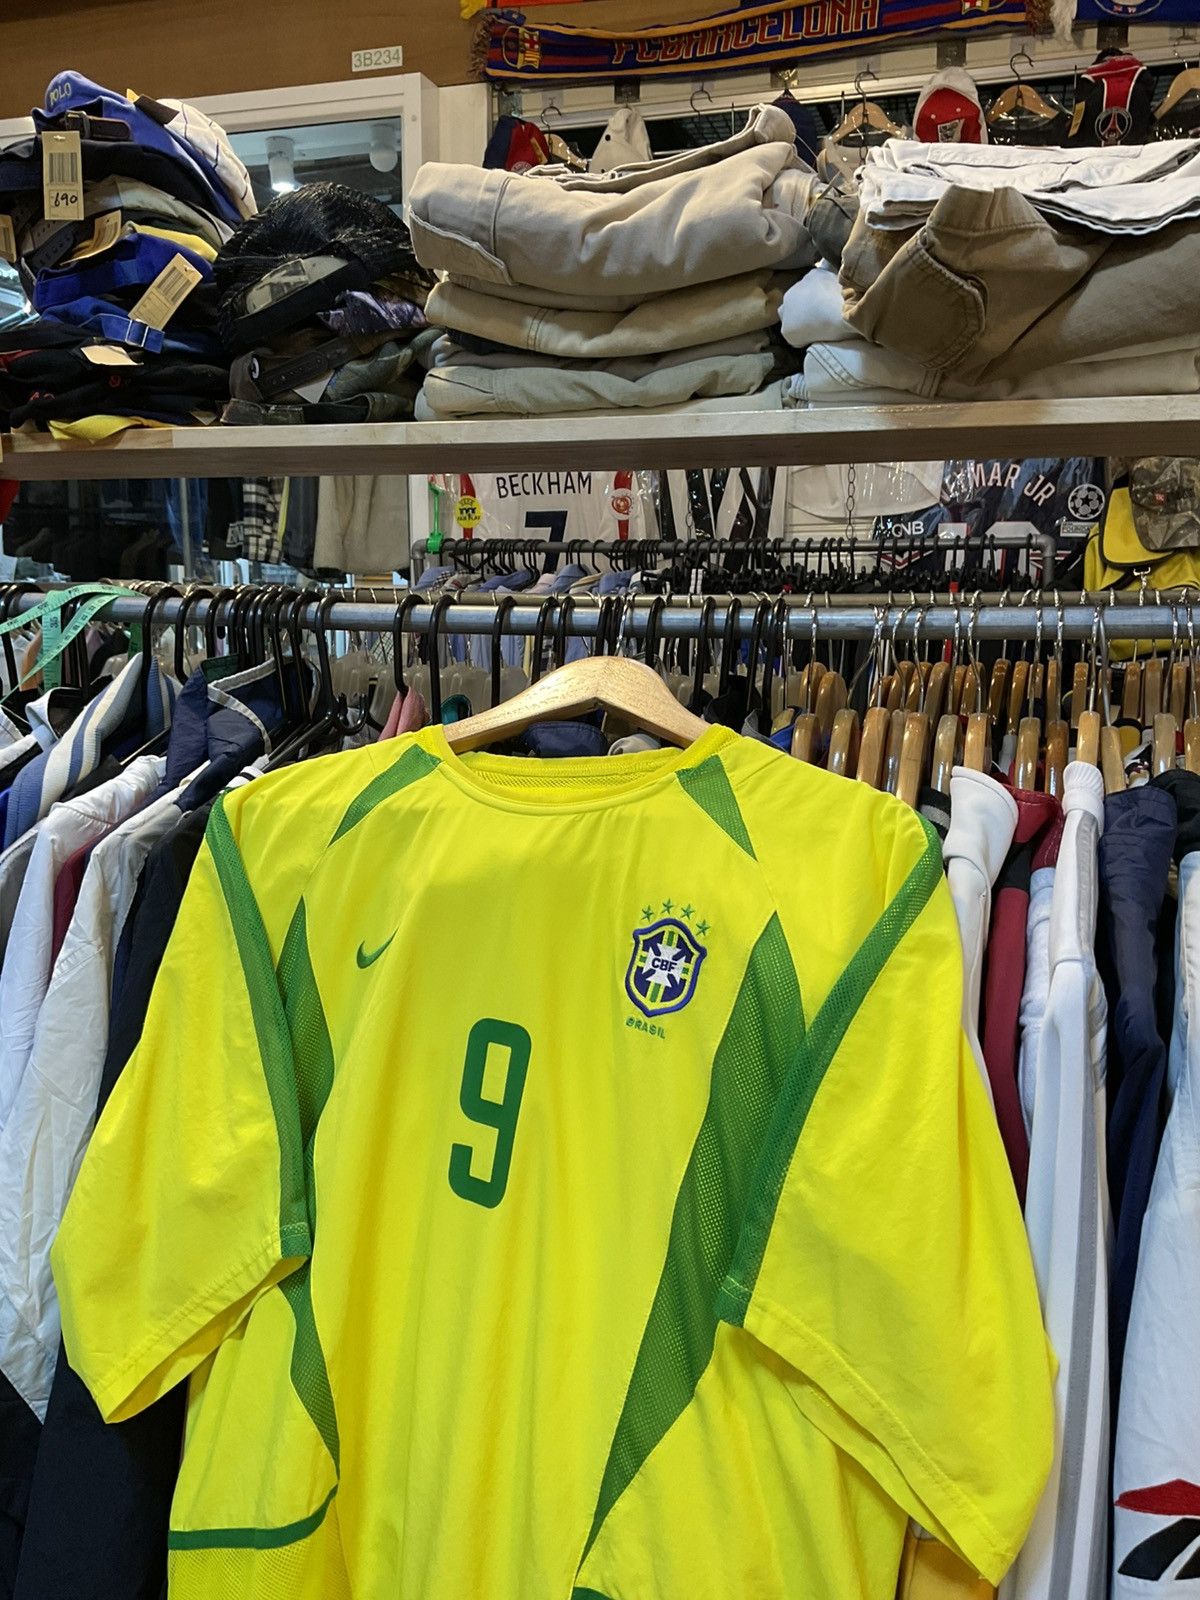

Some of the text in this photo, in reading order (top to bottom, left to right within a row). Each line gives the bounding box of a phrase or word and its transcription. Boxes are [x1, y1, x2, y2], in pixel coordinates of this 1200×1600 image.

[353, 48, 401, 68] 3B234
[50, 82, 72, 106] POLO
[54, 192, 78, 207] 690
[496, 472, 592, 499] BECKHAM
[1022, 474, 1056, 507] JR
[892, 520, 924, 538] QNB
[524, 510, 568, 574] 7
[651, 957, 677, 973] CBF
[625, 1016, 666, 1040] BRASIL
[448, 1017, 532, 1209] 9
